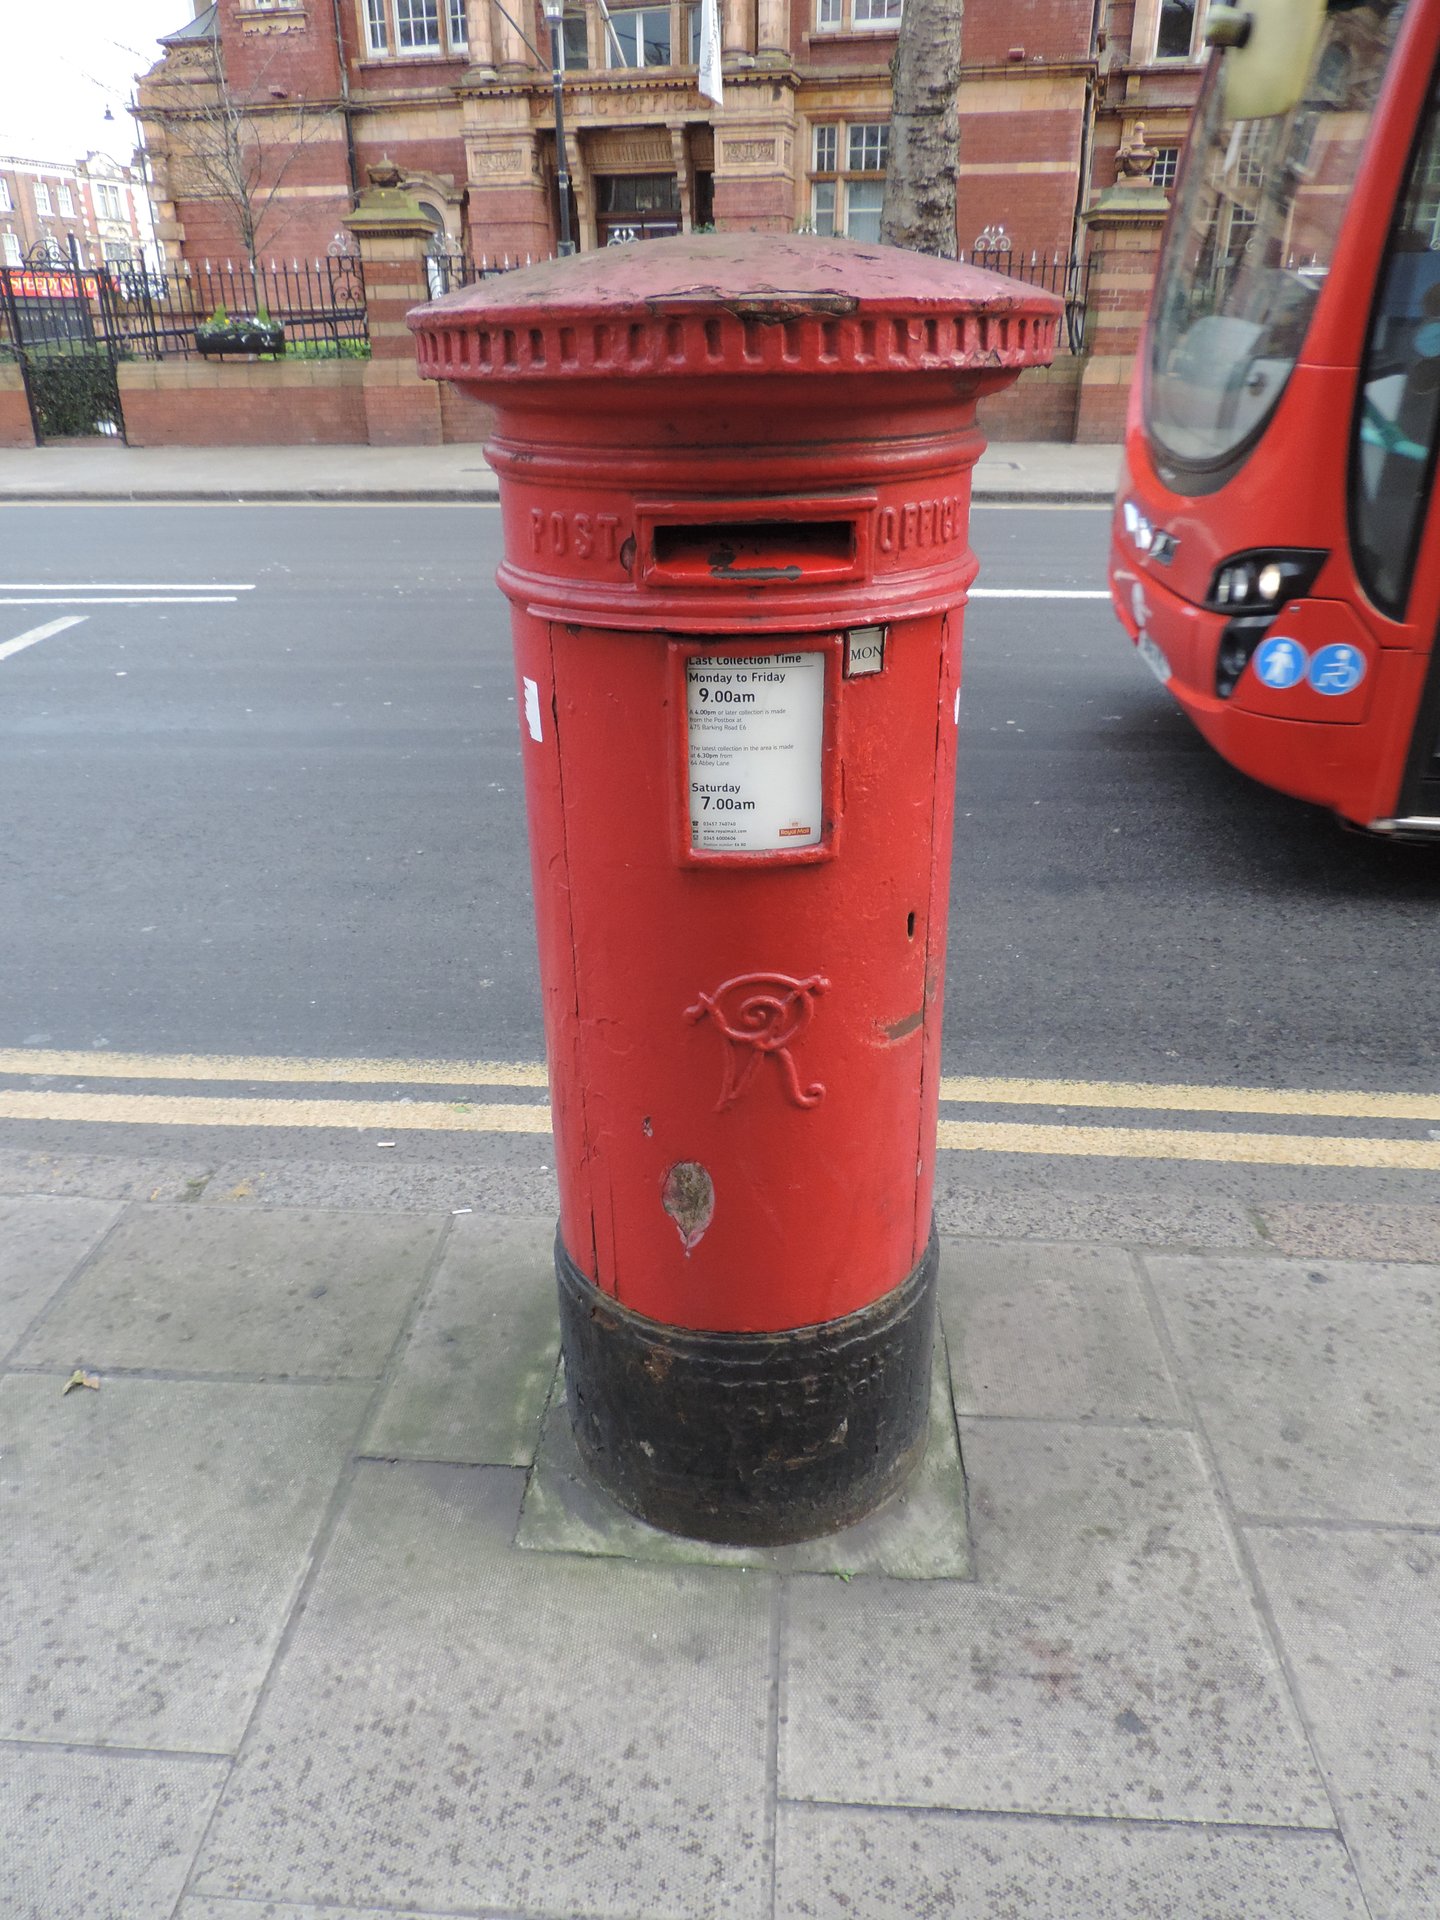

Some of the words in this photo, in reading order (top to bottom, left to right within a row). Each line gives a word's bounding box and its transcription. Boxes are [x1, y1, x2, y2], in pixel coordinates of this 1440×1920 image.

[626, 91, 714, 113] OFFICES
[530, 508, 619, 563] POST
[877, 496, 959, 553] OFFICE
[716, 655, 771, 665] Collection
[774, 653, 802, 664] Time
[850, 646, 883, 661] MON
[689, 672, 733, 685] Monday
[736, 673, 748, 682] to
[751, 672, 786, 684] Friday
[699, 687, 756, 703] 9.00am
[701, 724, 723, 732] Barking
[691, 782, 741, 794] Saturday
[700, 795, 756, 810] 7.00am
